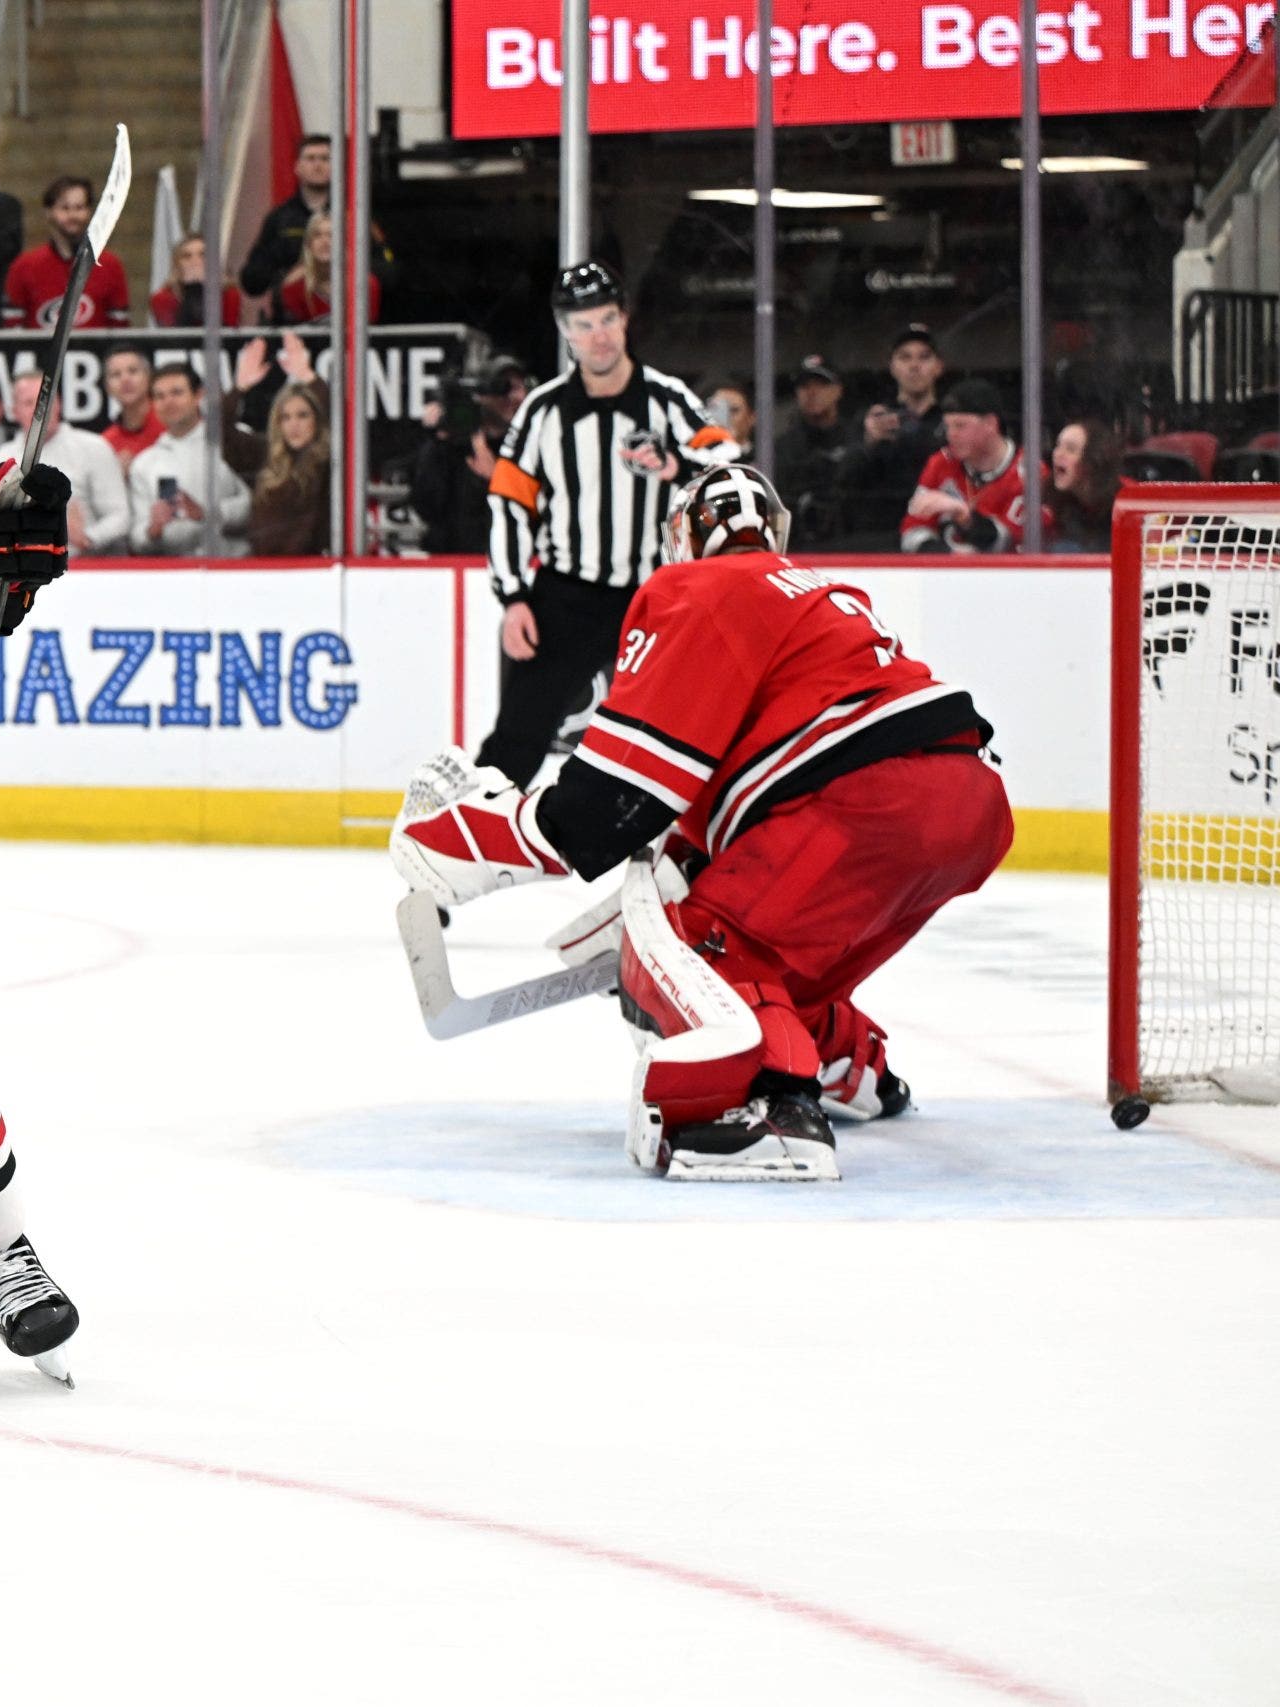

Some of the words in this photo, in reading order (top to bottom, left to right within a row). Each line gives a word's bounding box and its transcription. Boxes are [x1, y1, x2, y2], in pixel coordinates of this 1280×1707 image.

[486, 15, 669, 90] Built
[690, 15, 899, 80] Here.
[921, 1, 1104, 69] Best
[901, 124, 945, 161] EXIT
[616, 628, 657, 675] 31
[648, 952, 704, 1030] TRUE
